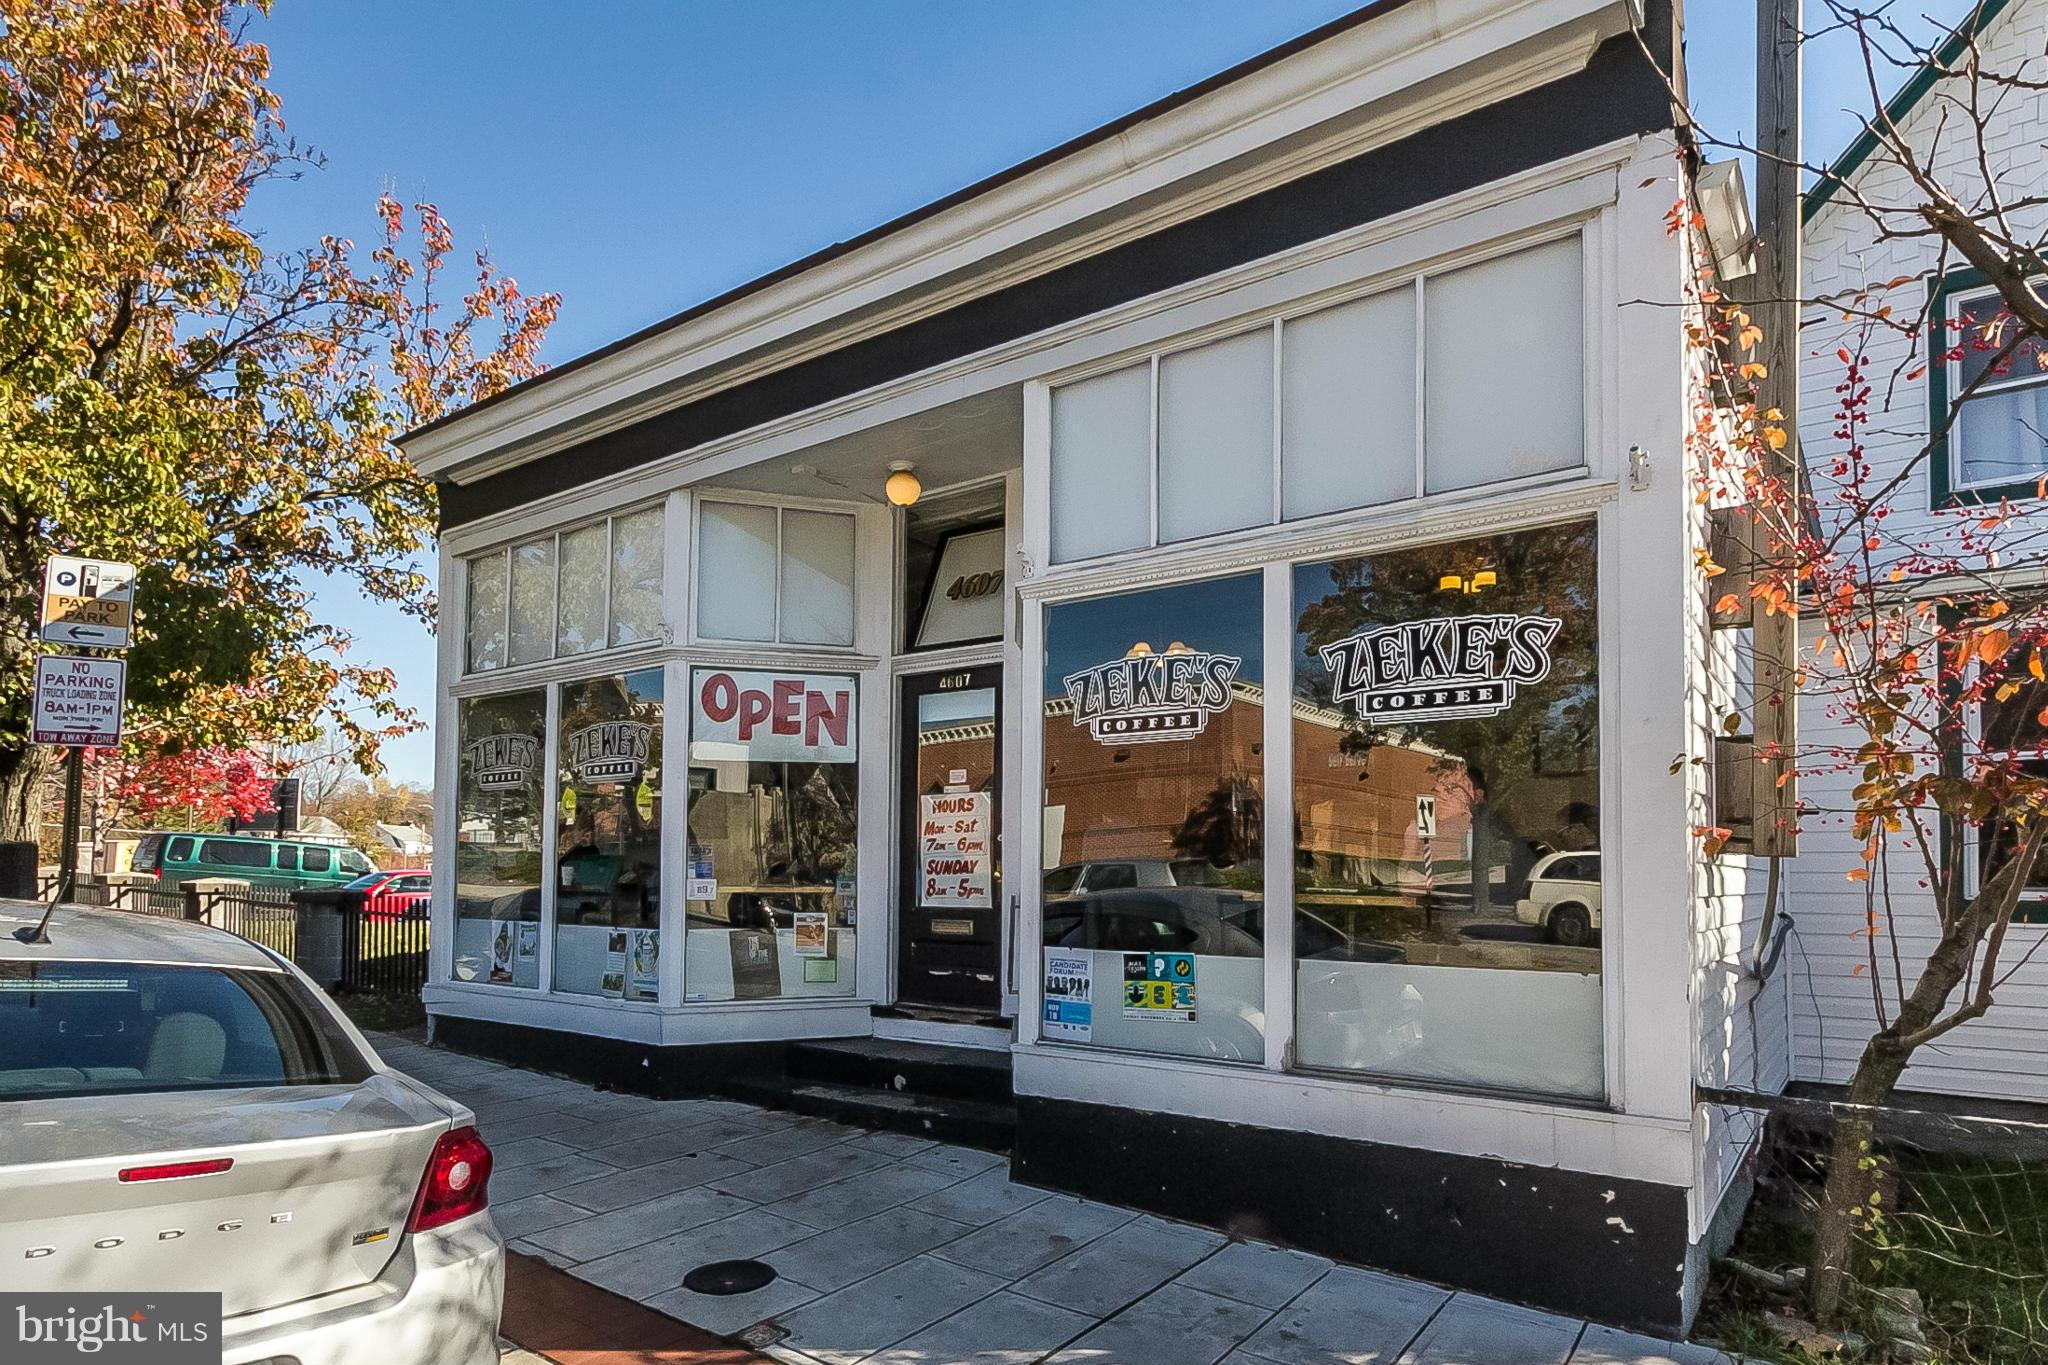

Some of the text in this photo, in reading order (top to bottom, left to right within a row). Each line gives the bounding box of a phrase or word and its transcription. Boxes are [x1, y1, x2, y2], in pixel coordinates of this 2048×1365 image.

[945, 570, 1004, 601] 4607
[59, 597, 119, 613] PAY TO
[64, 611, 111, 624] PARK
[1319, 613, 1562, 703] ZEKE'S
[71, 662, 91, 675] NO
[45, 674, 115, 689] PARKING
[939, 673, 971, 689] 4607
[1063, 651, 1242, 727] ZEKE'S
[42, 688, 117, 700] TRUCK LOADING ZONE
[1372, 687, 1494, 710] COFFEE
[44, 701, 114, 716] 8AM-1PM
[701, 672, 850, 747] OPEN
[1103, 715, 1192, 732] COFFEE
[38, 731, 116, 744] TOW AWAY ZONE
[568, 720, 652, 769] ZEKE'S
[468, 733, 538, 779] ZEKE'S
[587, 763, 631, 776] COFFEE
[482, 773, 520, 785] COFFEE
[932, 797, 975, 814] HOURS
[926, 859, 979, 876] SUNDAY
[1049, 960, 1089, 971] CANDIDATE
[25, 1212, 293, 1259] DODGE
